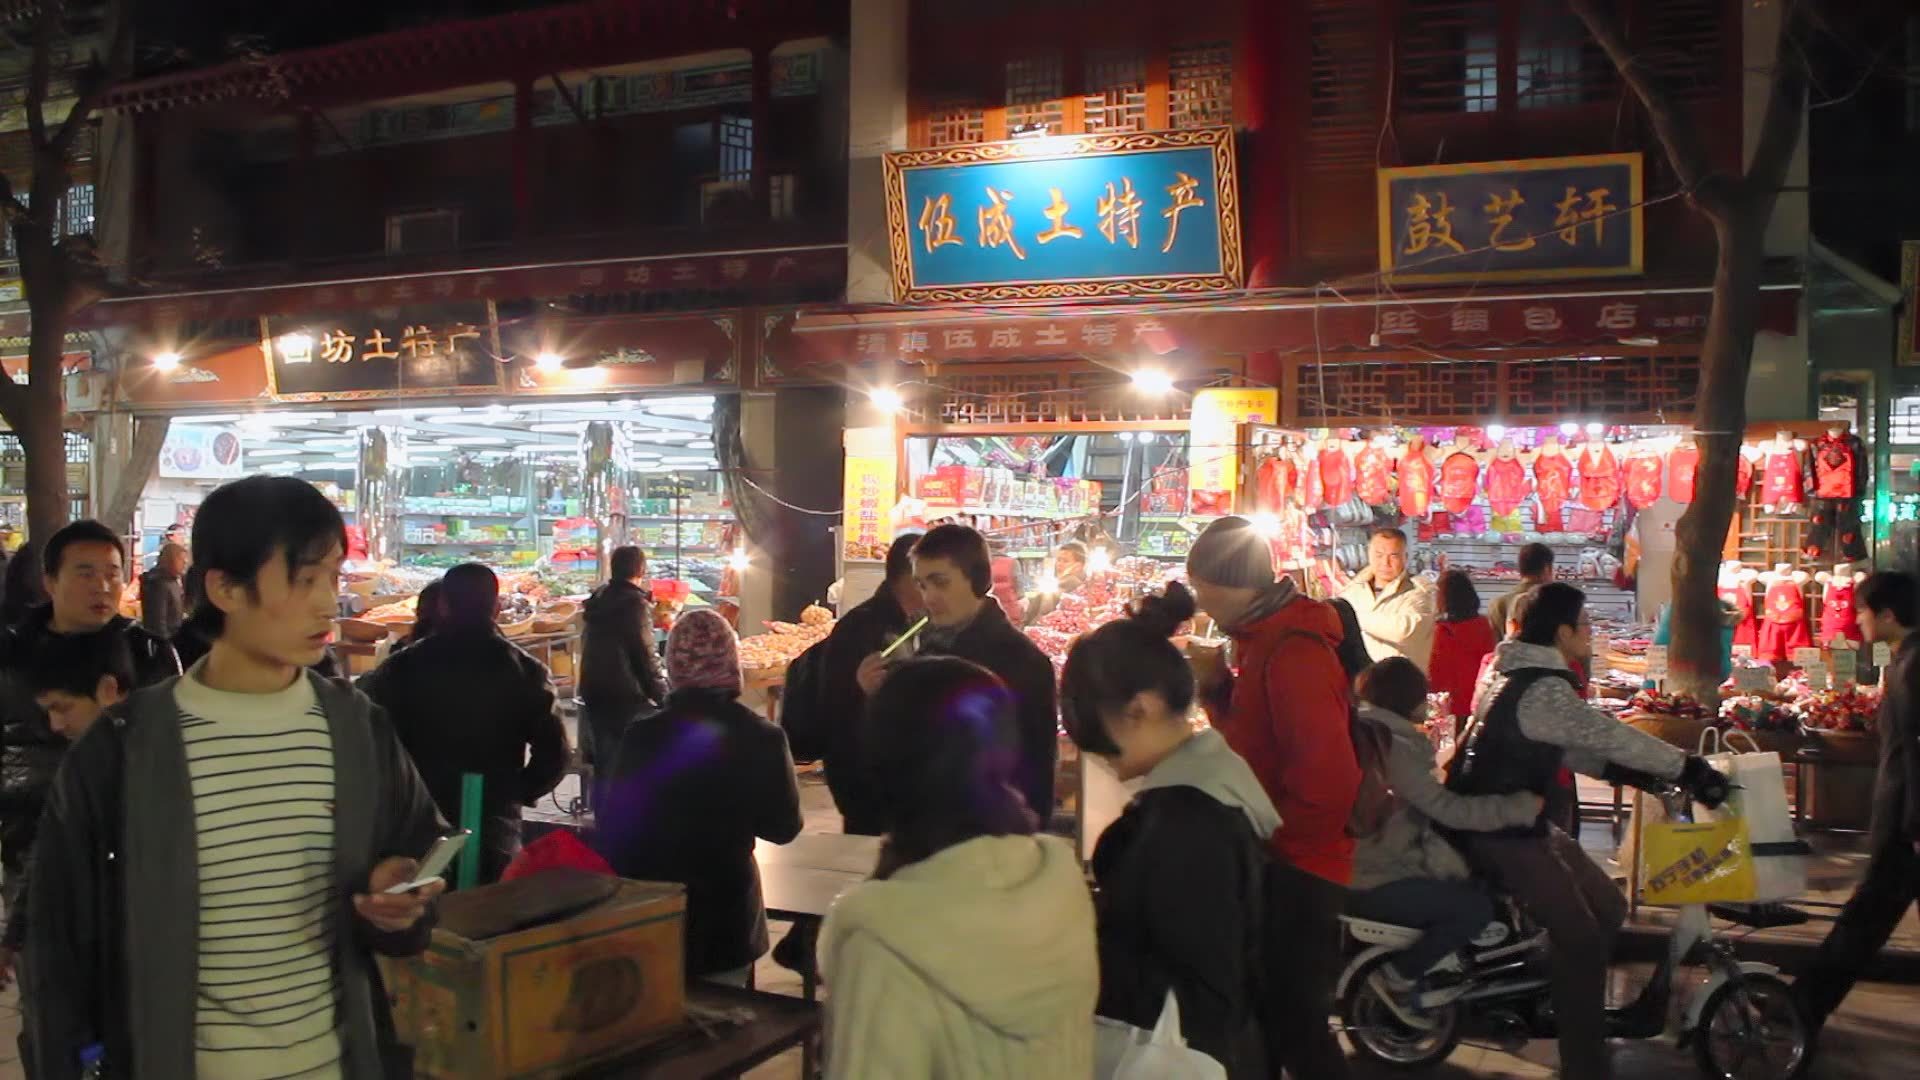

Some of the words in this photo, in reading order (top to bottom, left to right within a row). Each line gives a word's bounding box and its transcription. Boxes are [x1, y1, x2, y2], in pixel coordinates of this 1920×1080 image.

[918, 171, 1205, 260] 伍成土特产
[1404, 186, 1616, 255] 鼓艺轩
[1379, 302, 1638, 335] 丝绸包店
